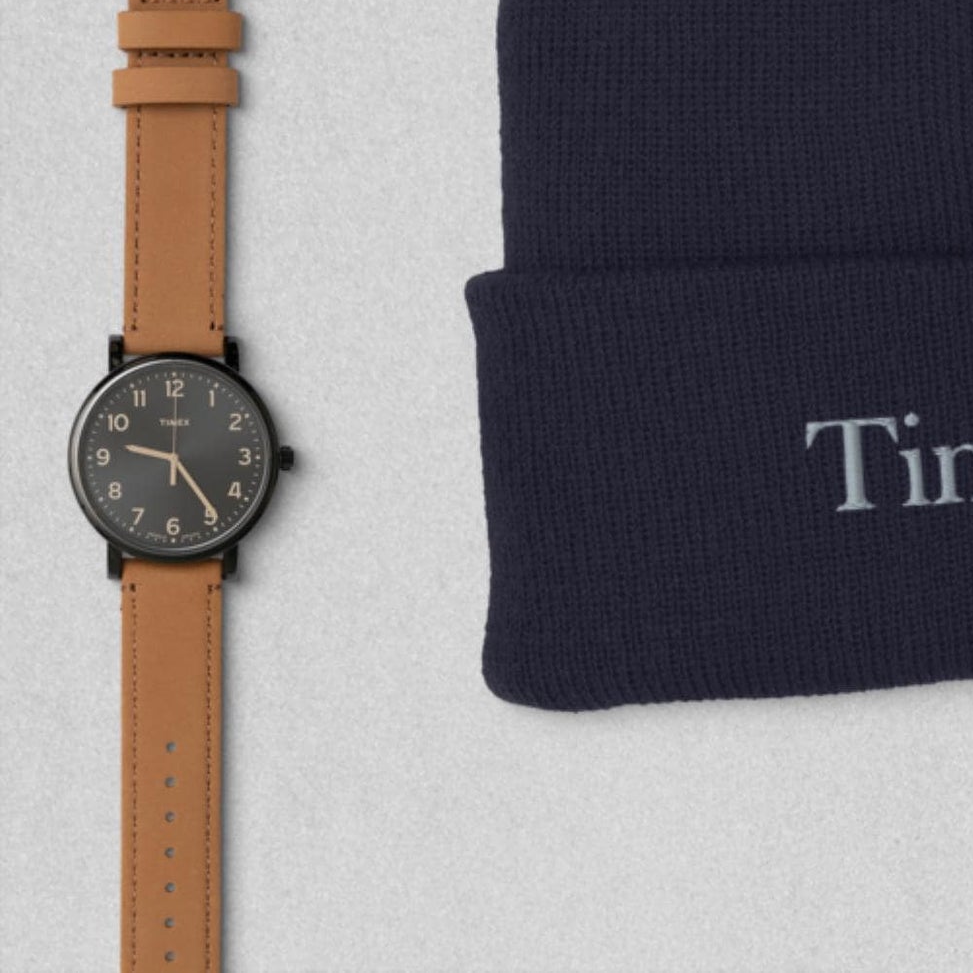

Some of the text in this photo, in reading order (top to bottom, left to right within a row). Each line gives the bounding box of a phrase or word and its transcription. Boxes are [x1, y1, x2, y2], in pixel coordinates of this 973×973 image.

[165, 380, 184, 398] 12
[133, 390, 146, 407] 11
[208, 390, 215, 408] 1
[107, 413, 129, 432] 10
[159, 418, 190, 427] TIMEX
[229, 413, 242, 431] 2
[96, 448, 110, 466] 9
[238, 448, 251, 466] 3
[108, 482, 122, 500] 8
[227, 482, 242, 499] 4
[131, 507, 145, 525] 7
[166, 517, 180, 536] 6
